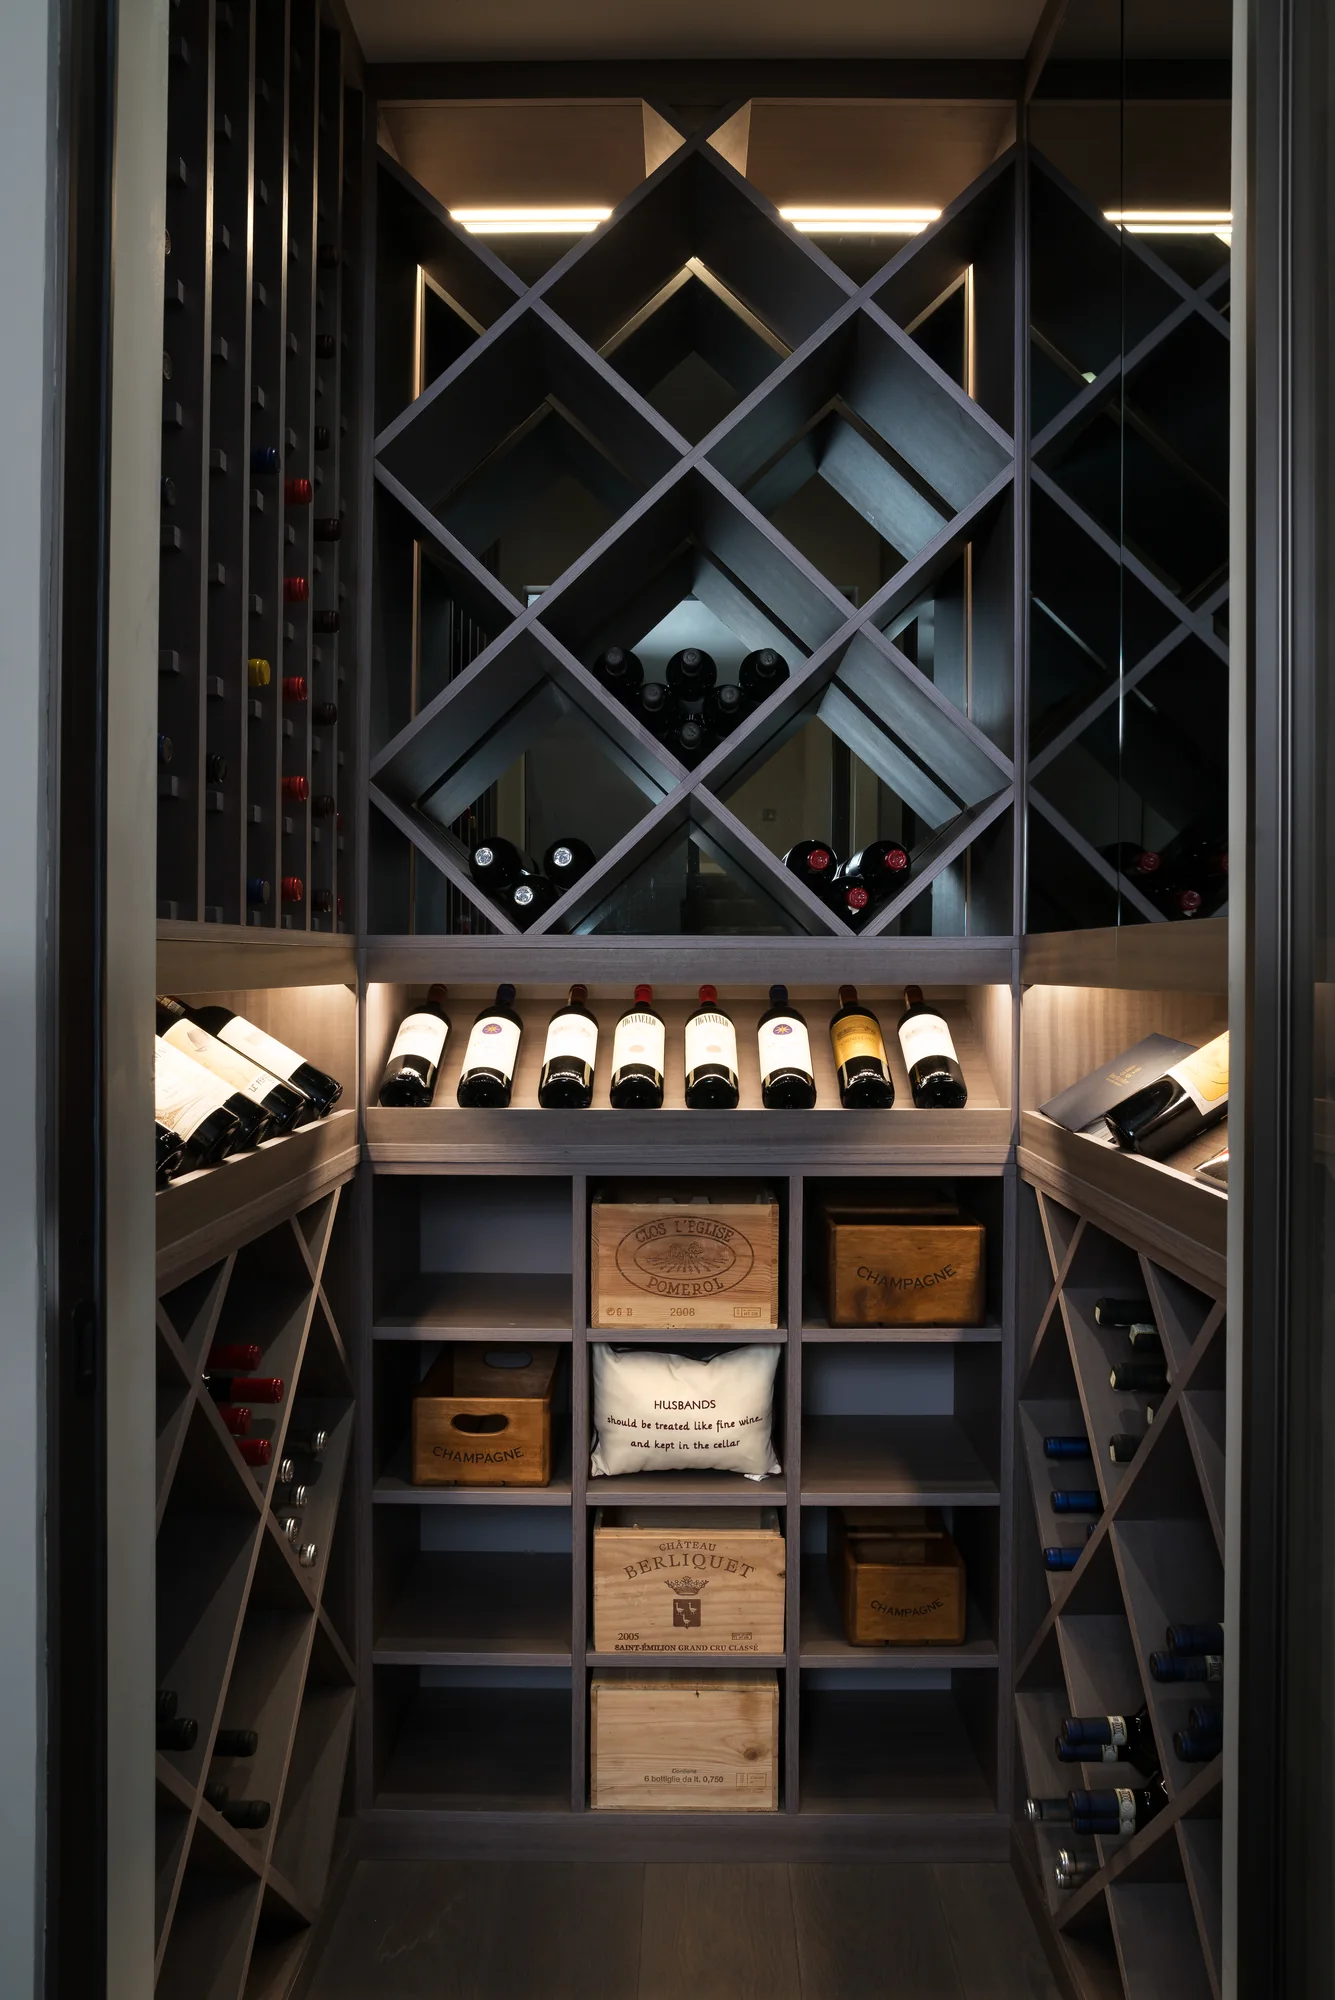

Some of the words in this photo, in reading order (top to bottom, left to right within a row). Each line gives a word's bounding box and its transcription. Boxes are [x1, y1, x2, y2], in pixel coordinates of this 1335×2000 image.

[635, 1222, 667, 1243] CLOS
[856, 1263, 957, 1290] CHAMPAGNE
[645, 1276, 725, 1296] POMEROL
[670, 1307, 695, 1317] 2008
[654, 1400, 717, 1410] HUSBANDS
[607, 1415, 638, 1429] should
[641, 1417, 652, 1429] be
[655, 1420, 690, 1431] treated
[694, 1420, 713, 1431] like
[716, 1419, 736, 1433] fine
[630, 1440, 651, 1449] and
[654, 1440, 675, 1452] kept
[678, 1441, 690, 1450] in
[693, 1440, 710, 1450] the
[713, 1439, 741, 1449] cellar
[432, 1446, 525, 1464] CHAMPAGNE
[659, 1539, 717, 1552] CHÂTEAU
[623, 1553, 757, 1580] BERLIQUET
[870, 1598, 944, 1618] CHAMPAGNE
[617, 1632, 640, 1641] 2005
[614, 1643, 677, 1652] SAINT-ÉMILION
[678, 1644, 708, 1652] GRAND
[709, 1644, 727, 1652] CRU
[728, 1643, 759, 1652] CLASSÉ
[644, 1775, 650, 1783] 6
[651, 1775, 681, 1784] bottiglie
[682, 1775, 692, 1783] da
[702, 1775, 724, 1784] 0,750
